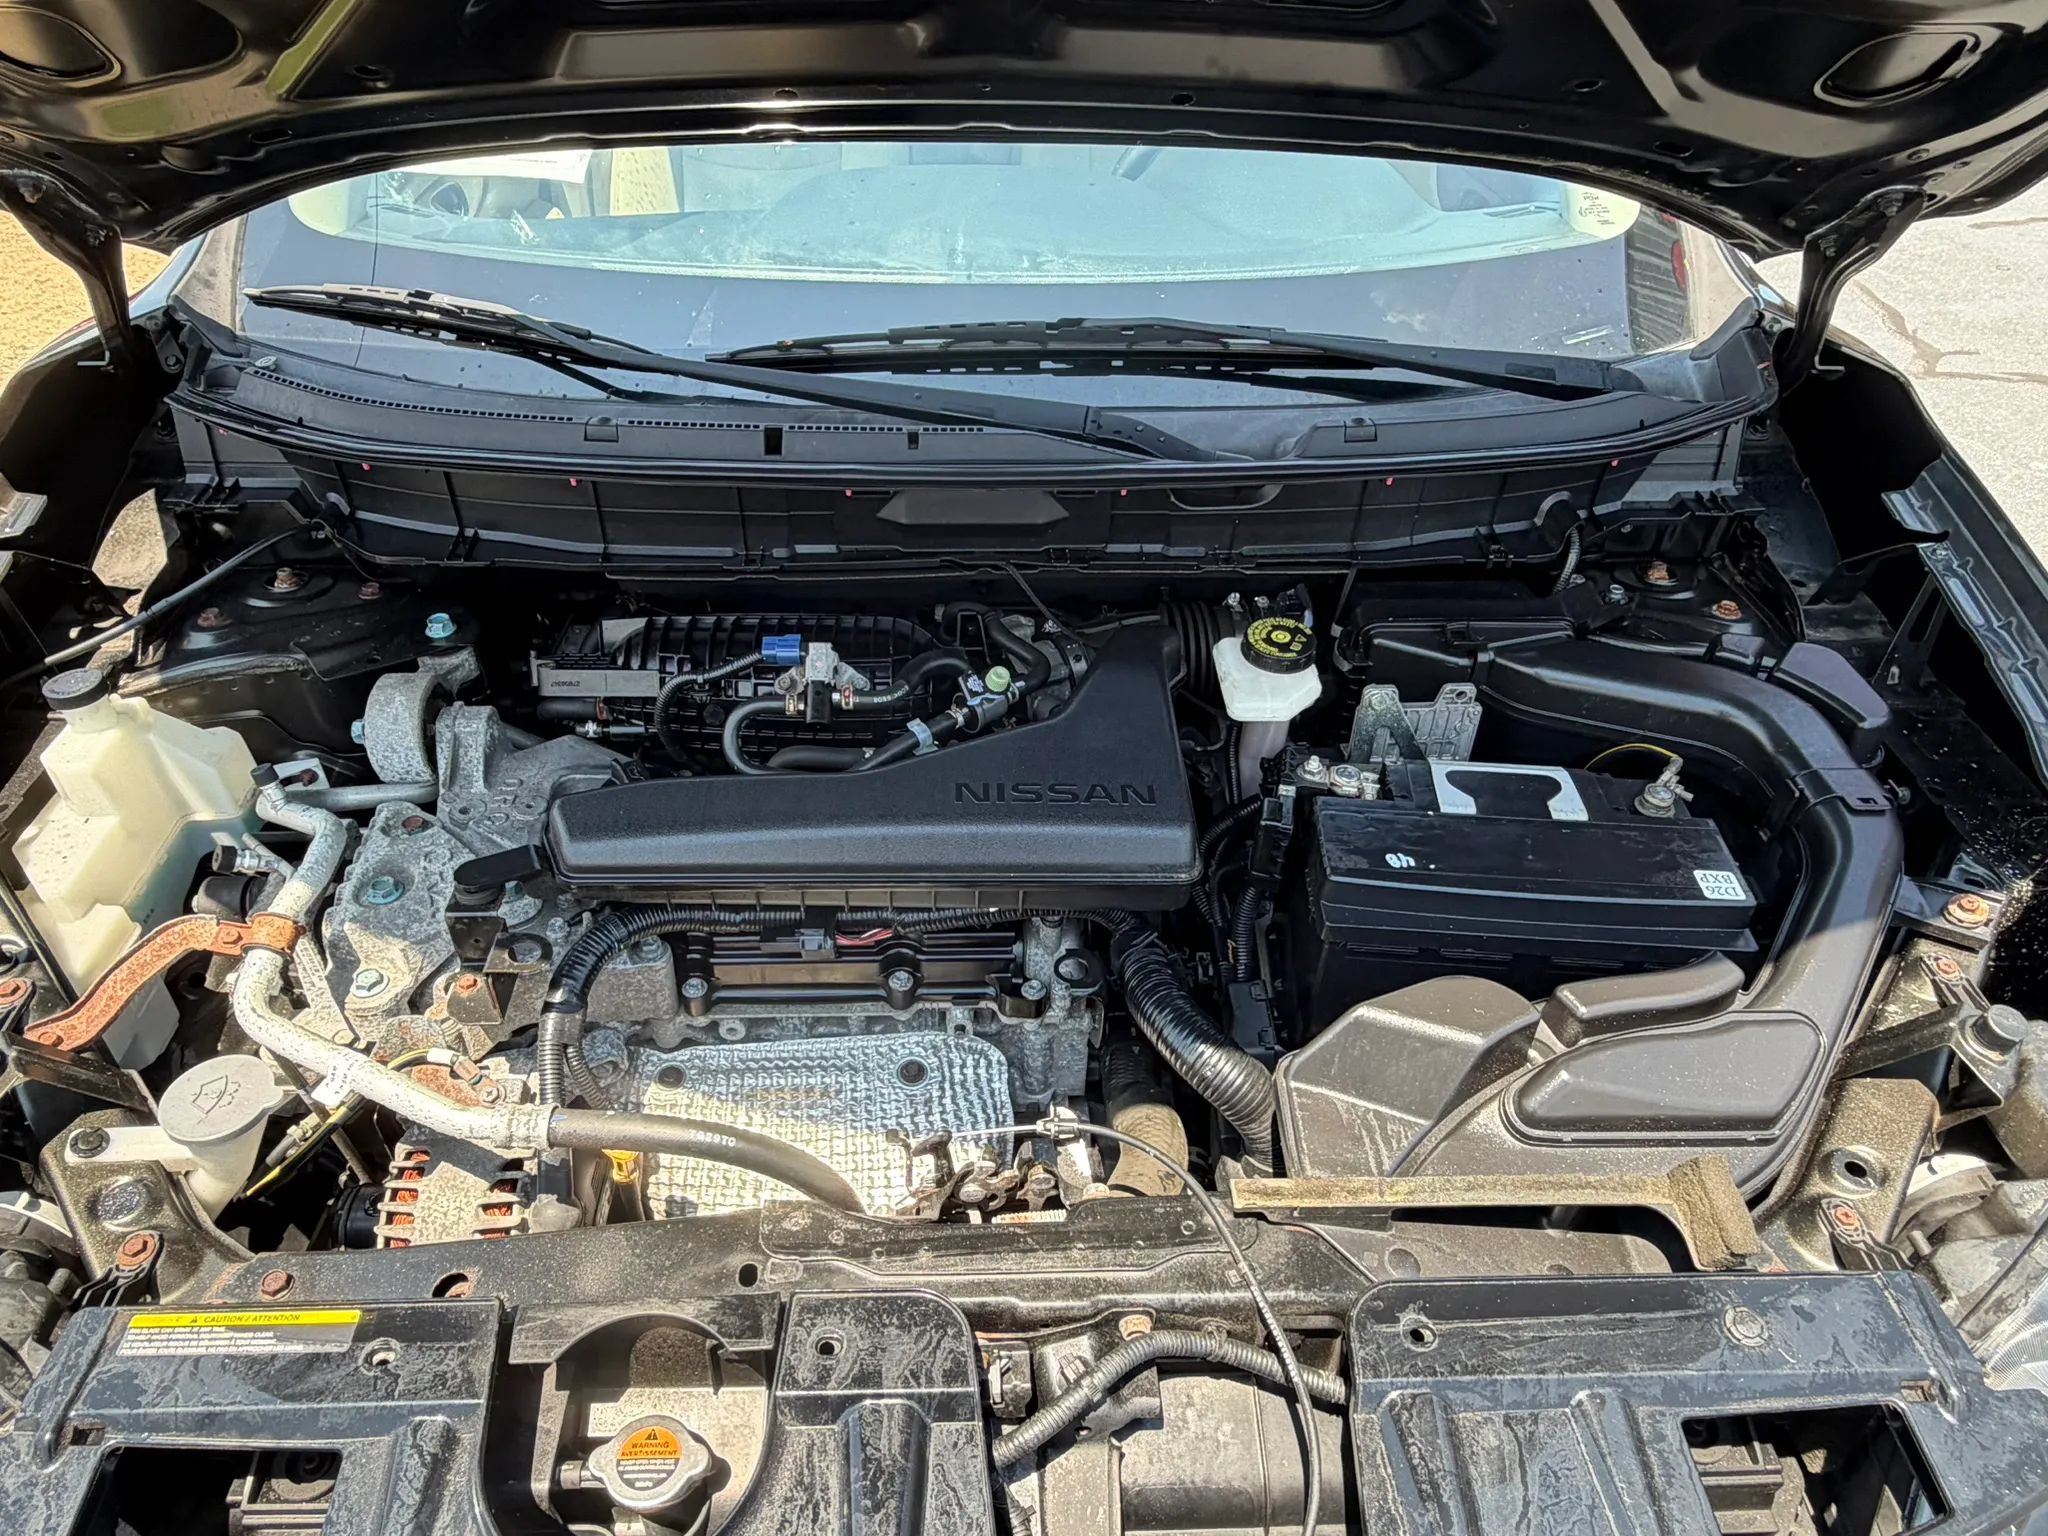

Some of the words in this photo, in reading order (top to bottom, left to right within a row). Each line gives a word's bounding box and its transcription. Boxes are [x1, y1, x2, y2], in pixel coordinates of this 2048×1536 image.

[954, 782, 1157, 806] NISSAN
[1700, 873, 1734, 885] BXP
[1705, 886, 1741, 897] D26
[203, 1315, 243, 1323] CAUTION
[251, 1314, 301, 1322] ATTENTION
[631, 1441, 670, 1449] WARNING
